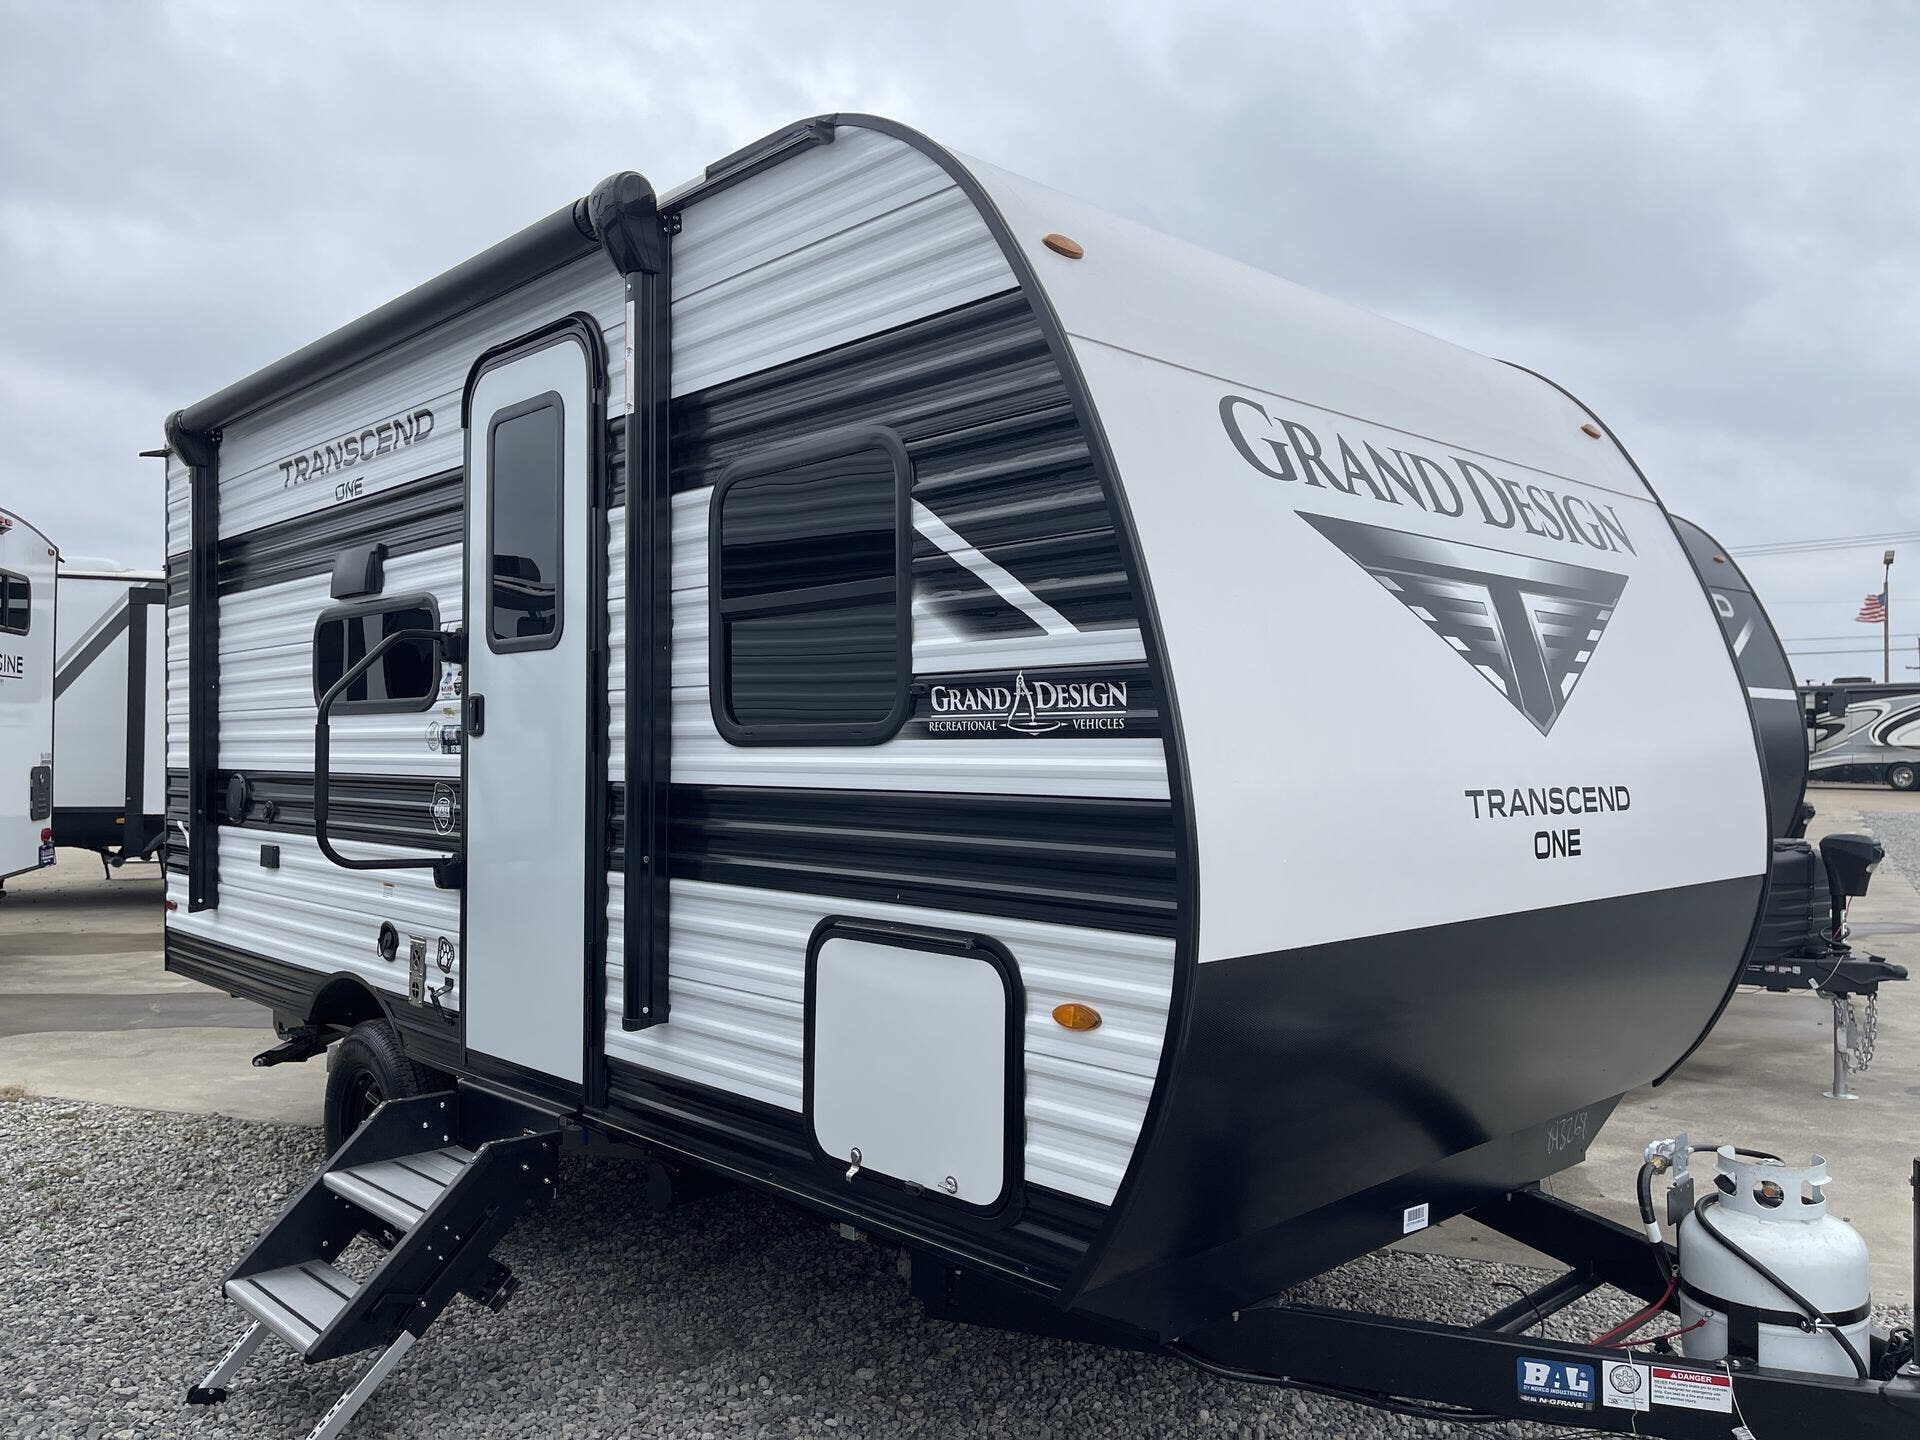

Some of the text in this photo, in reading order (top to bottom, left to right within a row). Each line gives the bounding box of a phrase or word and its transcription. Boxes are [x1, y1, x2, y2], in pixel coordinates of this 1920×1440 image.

[278, 408, 435, 488] TRANSCEND
[335, 476, 365, 502] ONE
[1218, 394, 1637, 557] GRAND DESIGN
[931, 681, 1127, 712] GRAND DESIGN
[929, 718, 1125, 732] RECREATIONAL VEHICLES
[1464, 785, 1631, 819] TRANSCEND
[1534, 828, 1582, 860] ONE
[1523, 1361, 1588, 1391] BAL
[1677, 1372, 1711, 1383] DANGER
